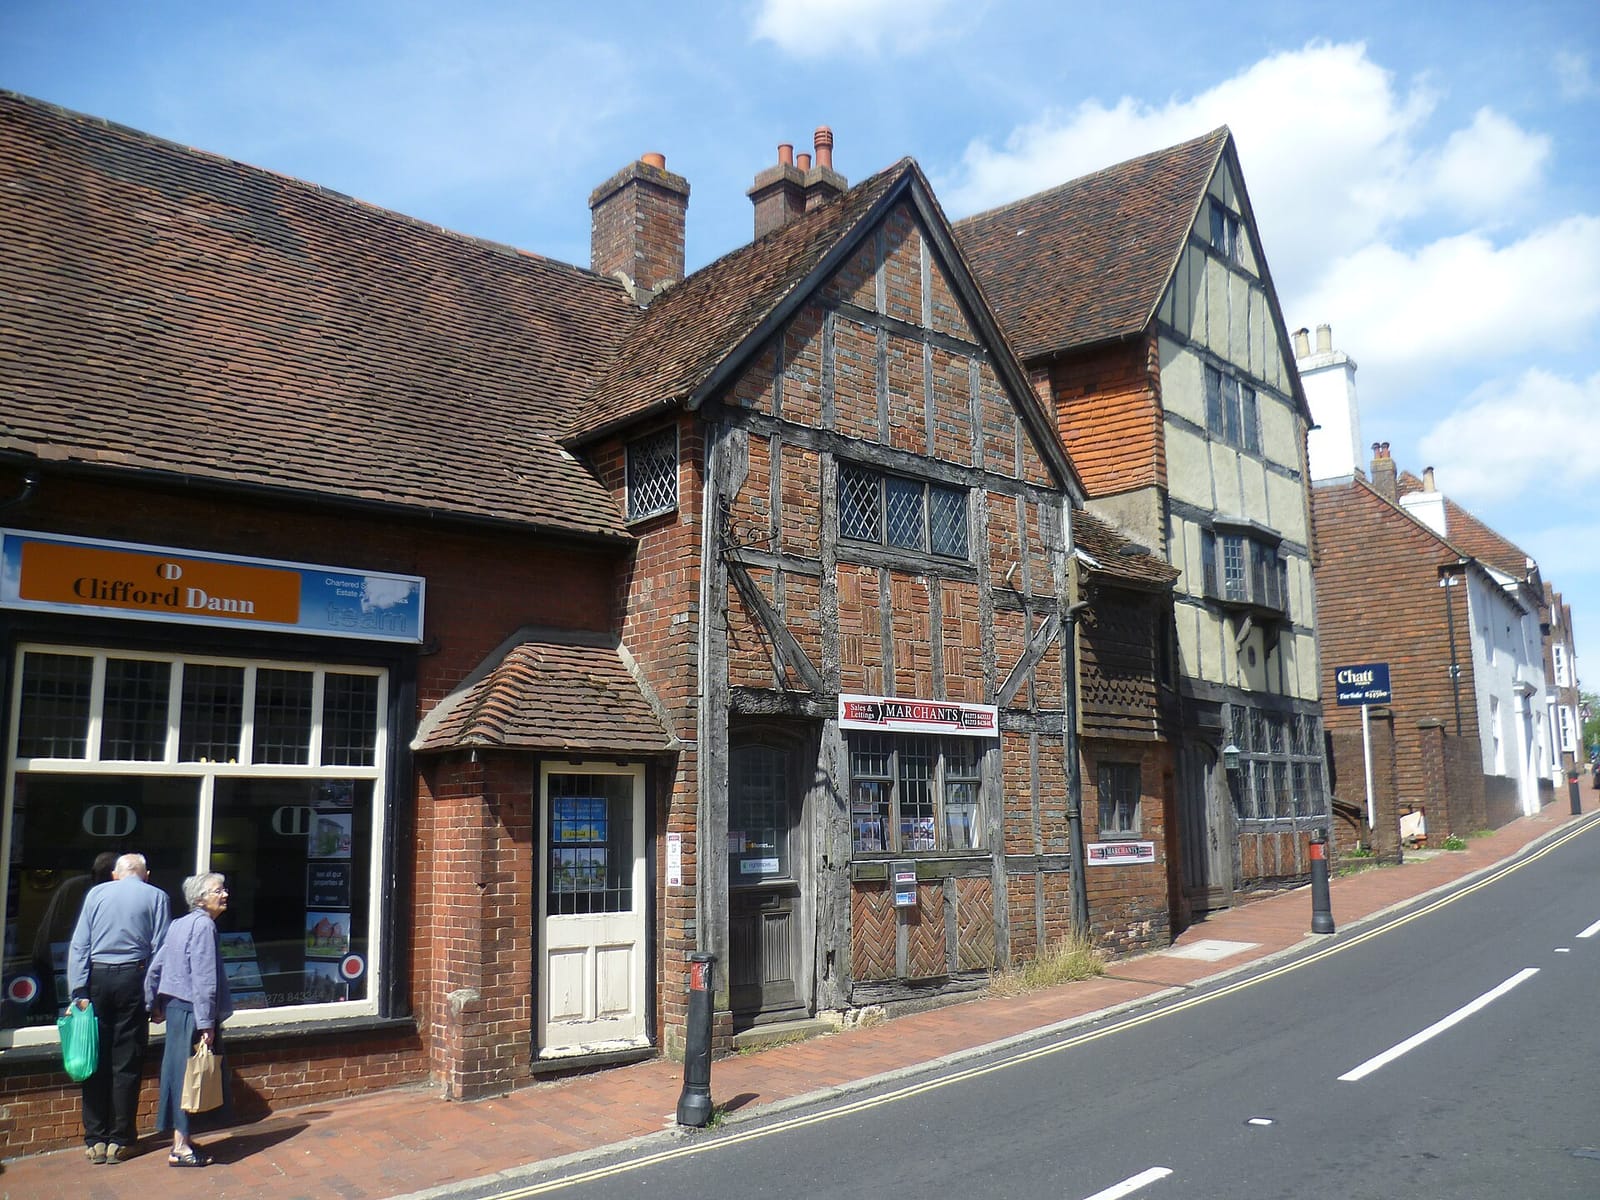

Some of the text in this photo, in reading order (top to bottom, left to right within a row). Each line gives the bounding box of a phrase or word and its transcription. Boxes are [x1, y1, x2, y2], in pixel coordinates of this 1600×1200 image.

[325, 578, 360, 589] Chartered
[73, 577, 256, 614] Clifford Dann
[336, 588, 358, 598] Estate
[327, 601, 407, 632] team
[1337, 669, 1374, 684] Chatt
[850, 703, 873, 712] Sales &
[886, 704, 958, 721] MARCHANTS
[850, 710, 875, 720] Lettings
